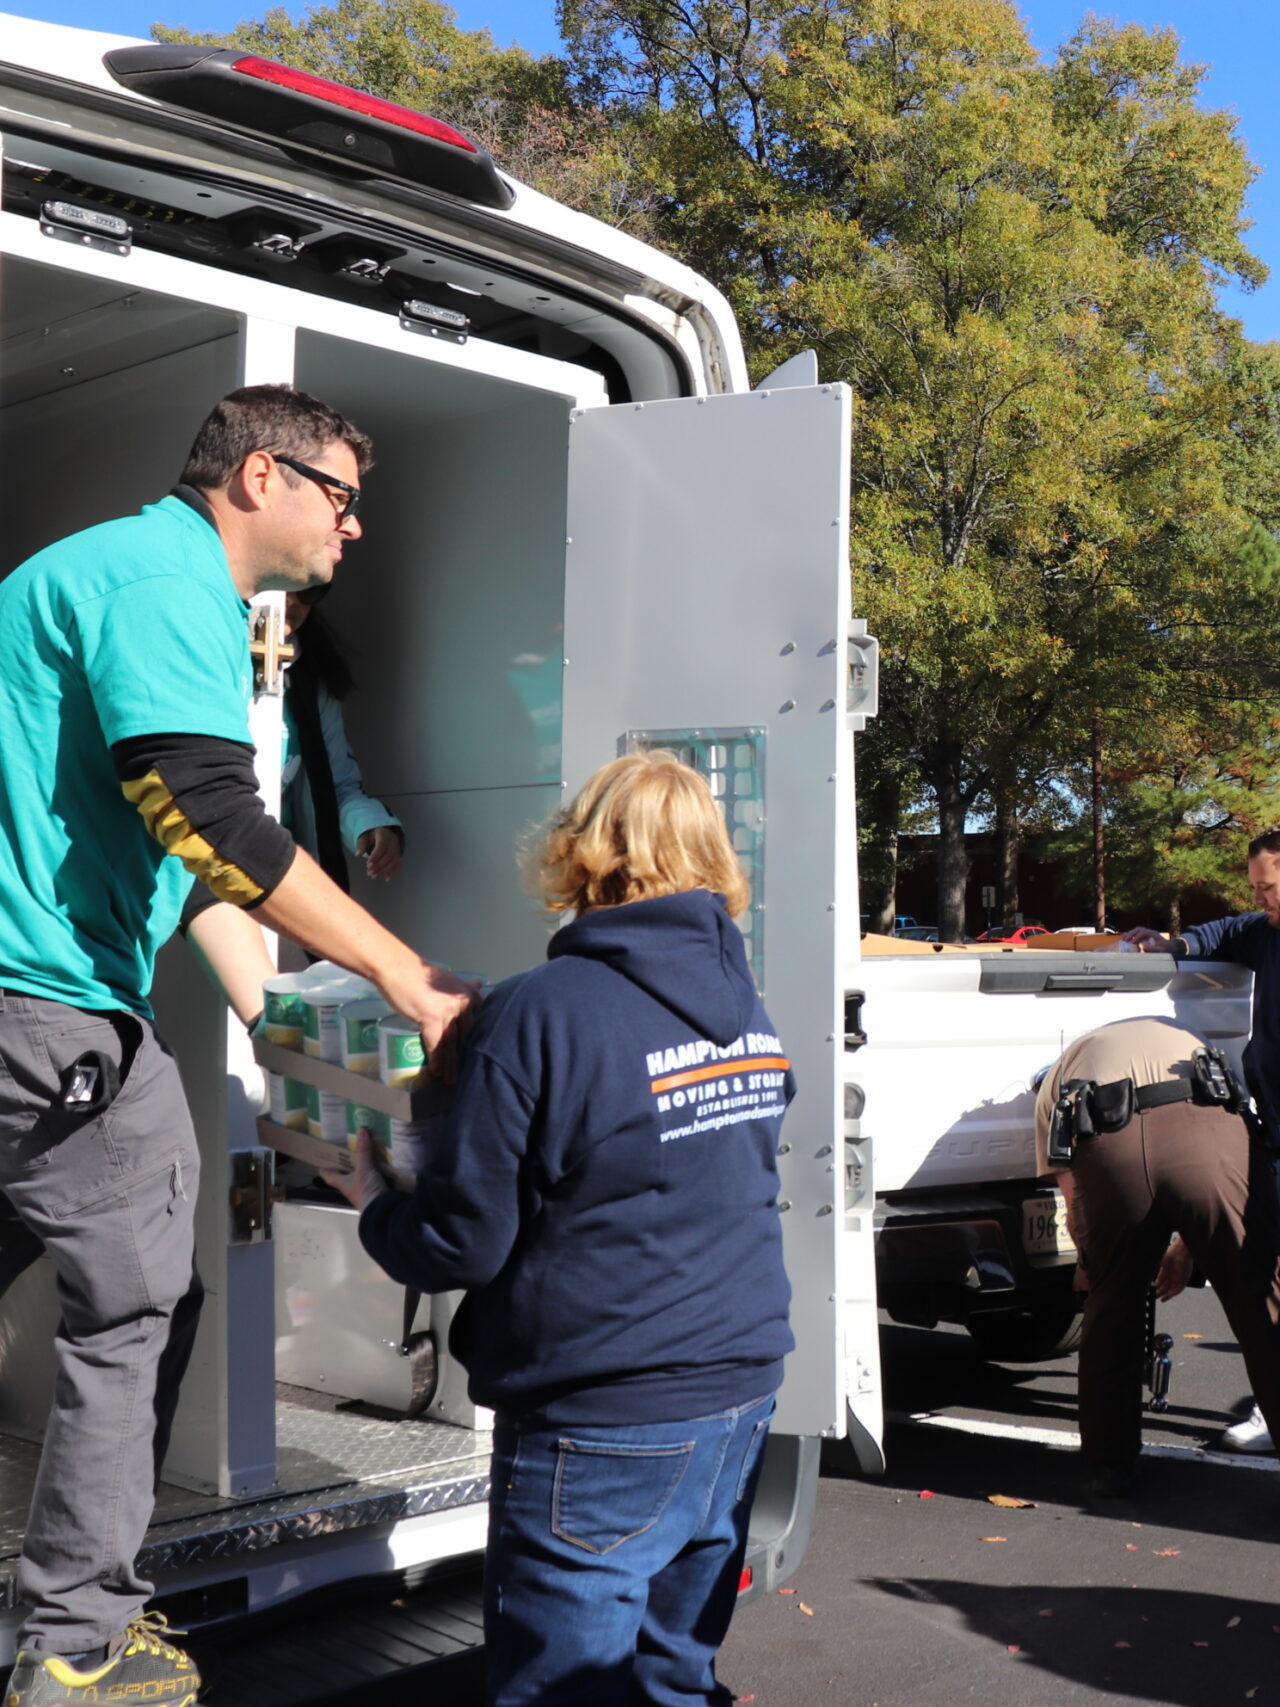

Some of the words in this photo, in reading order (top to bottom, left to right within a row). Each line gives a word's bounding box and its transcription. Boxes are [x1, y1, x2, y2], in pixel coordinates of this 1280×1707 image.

[646, 1037, 745, 1076] HAMPTON
[657, 1080, 729, 1113] MOVING
[732, 1077, 744, 1092] &
[696, 1093, 760, 1117] ESTABLISHED
